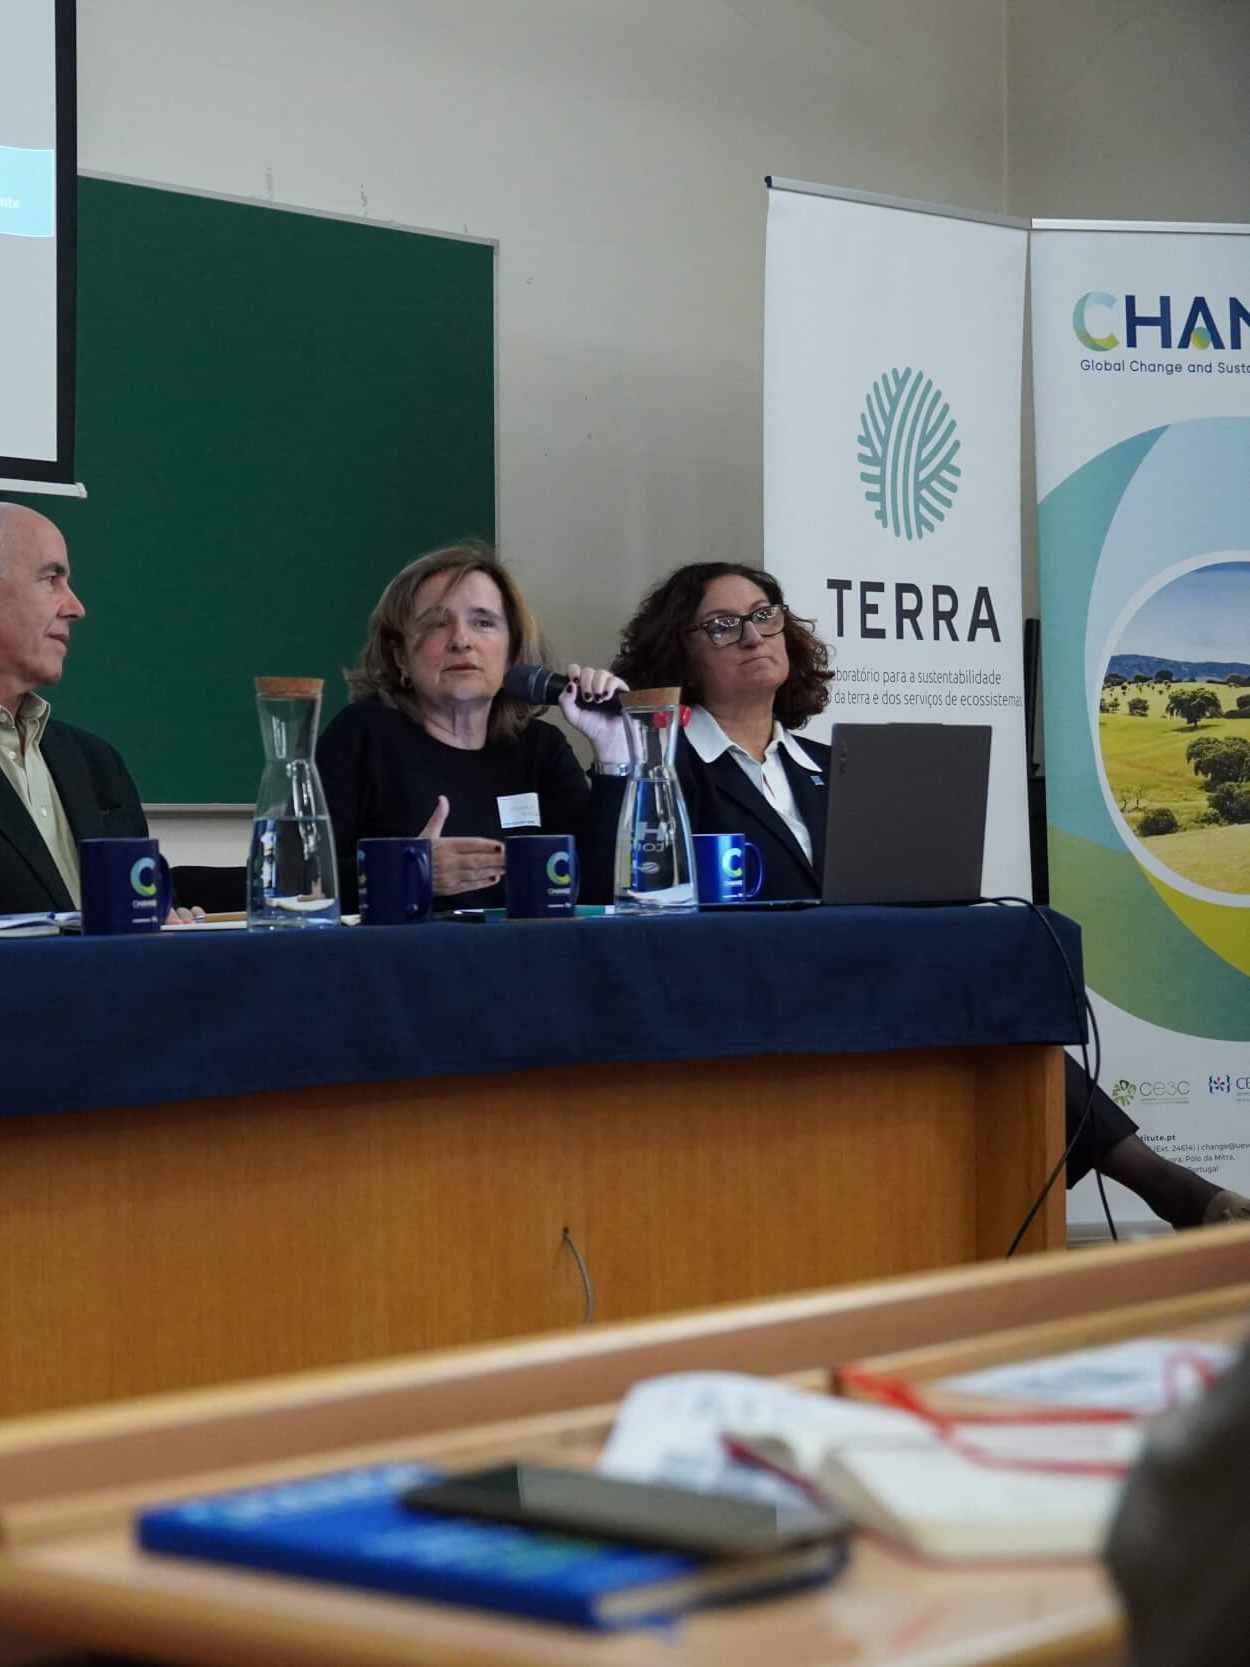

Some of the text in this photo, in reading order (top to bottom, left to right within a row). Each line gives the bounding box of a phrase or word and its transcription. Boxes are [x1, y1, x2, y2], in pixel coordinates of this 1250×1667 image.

[1080, 359, 1125, 372] Global
[1129, 360, 1183, 375] Change
[1187, 362, 1212, 374] and
[826, 578, 1002, 643] TERRA
[883, 671, 907, 686] para
[909, 671, 916, 683] a
[917, 668, 1002, 685] sustentabilidade
[834, 690, 846, 704] da
[847, 690, 870, 705] terra
[872, 693, 879, 705] e
[883, 690, 901, 706] dos
[903, 692, 943, 709] serviços
[945, 690, 958, 706] de
[960, 691, 1023, 708] ecossistemas
